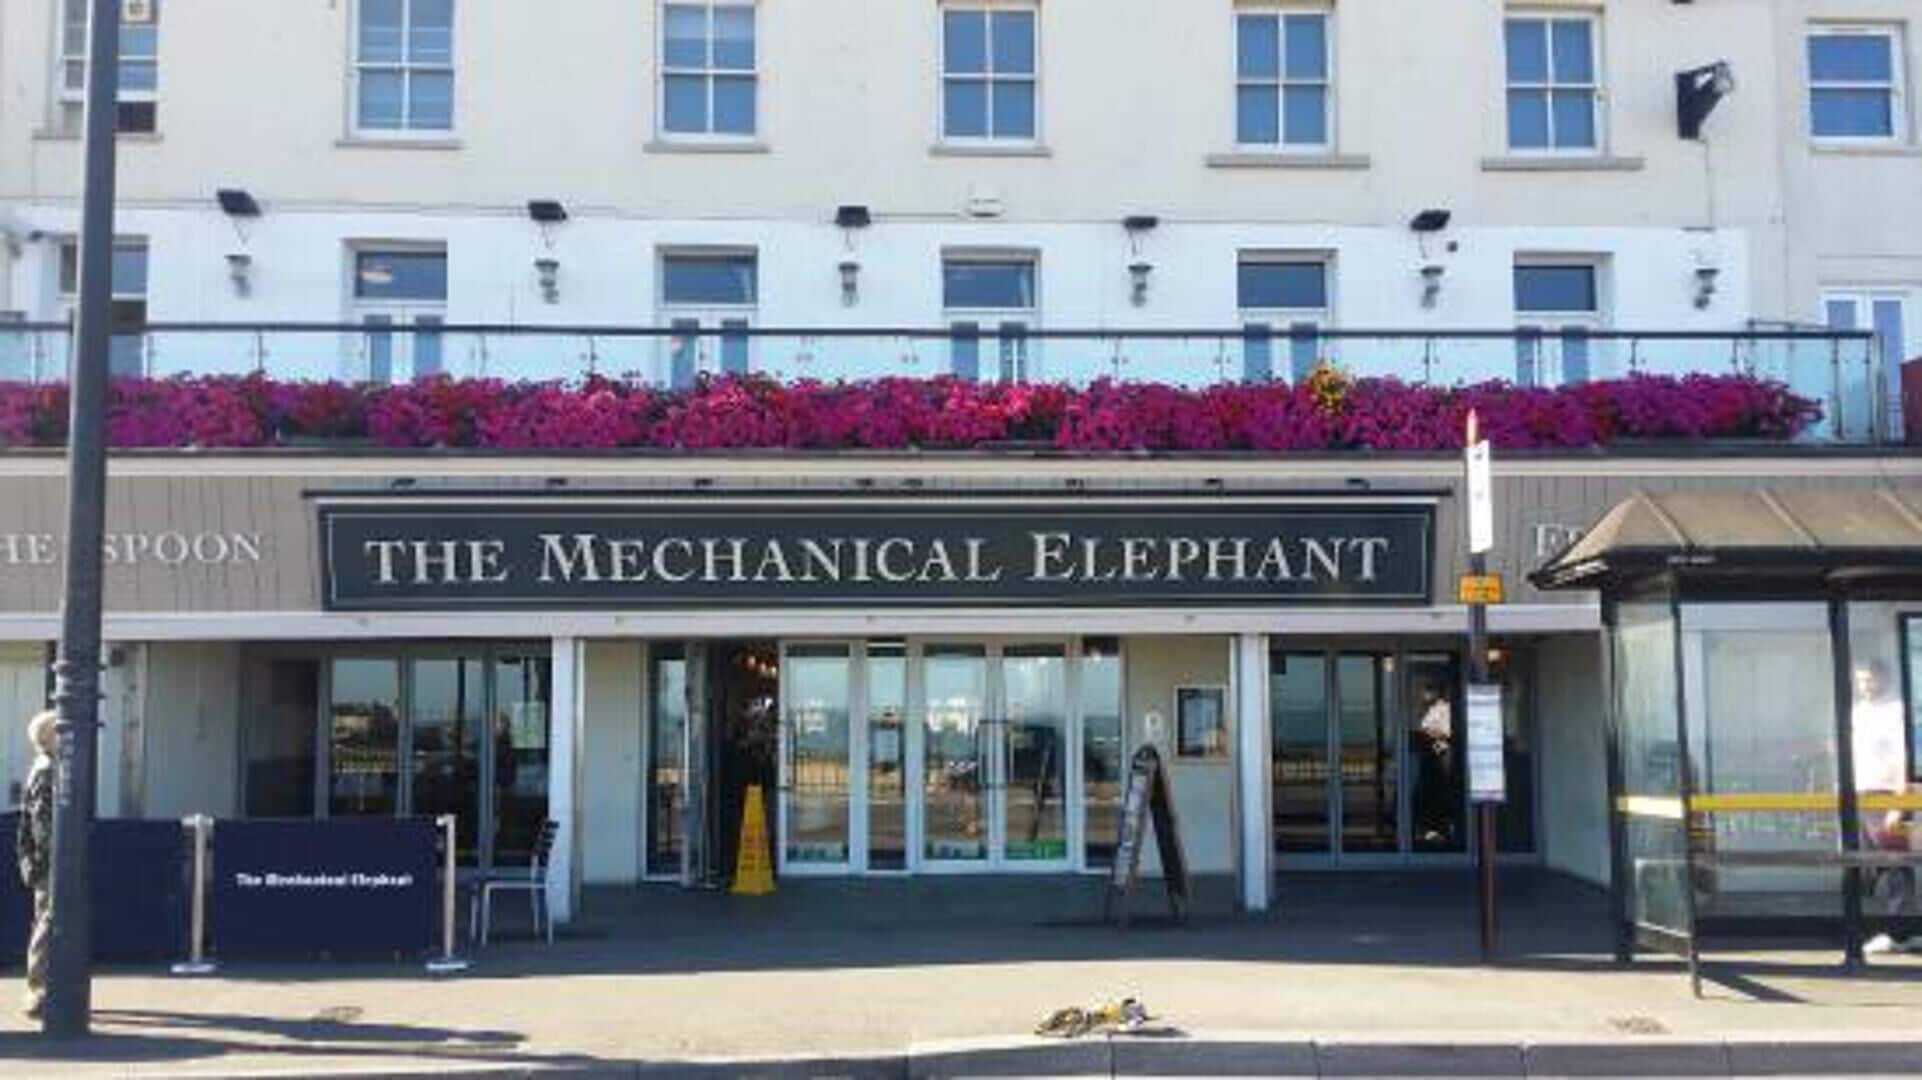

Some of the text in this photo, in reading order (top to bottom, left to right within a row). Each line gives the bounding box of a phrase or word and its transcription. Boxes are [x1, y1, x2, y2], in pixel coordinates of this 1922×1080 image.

[365, 532, 1388, 582] THE MECHANICAL ELEPHANT
